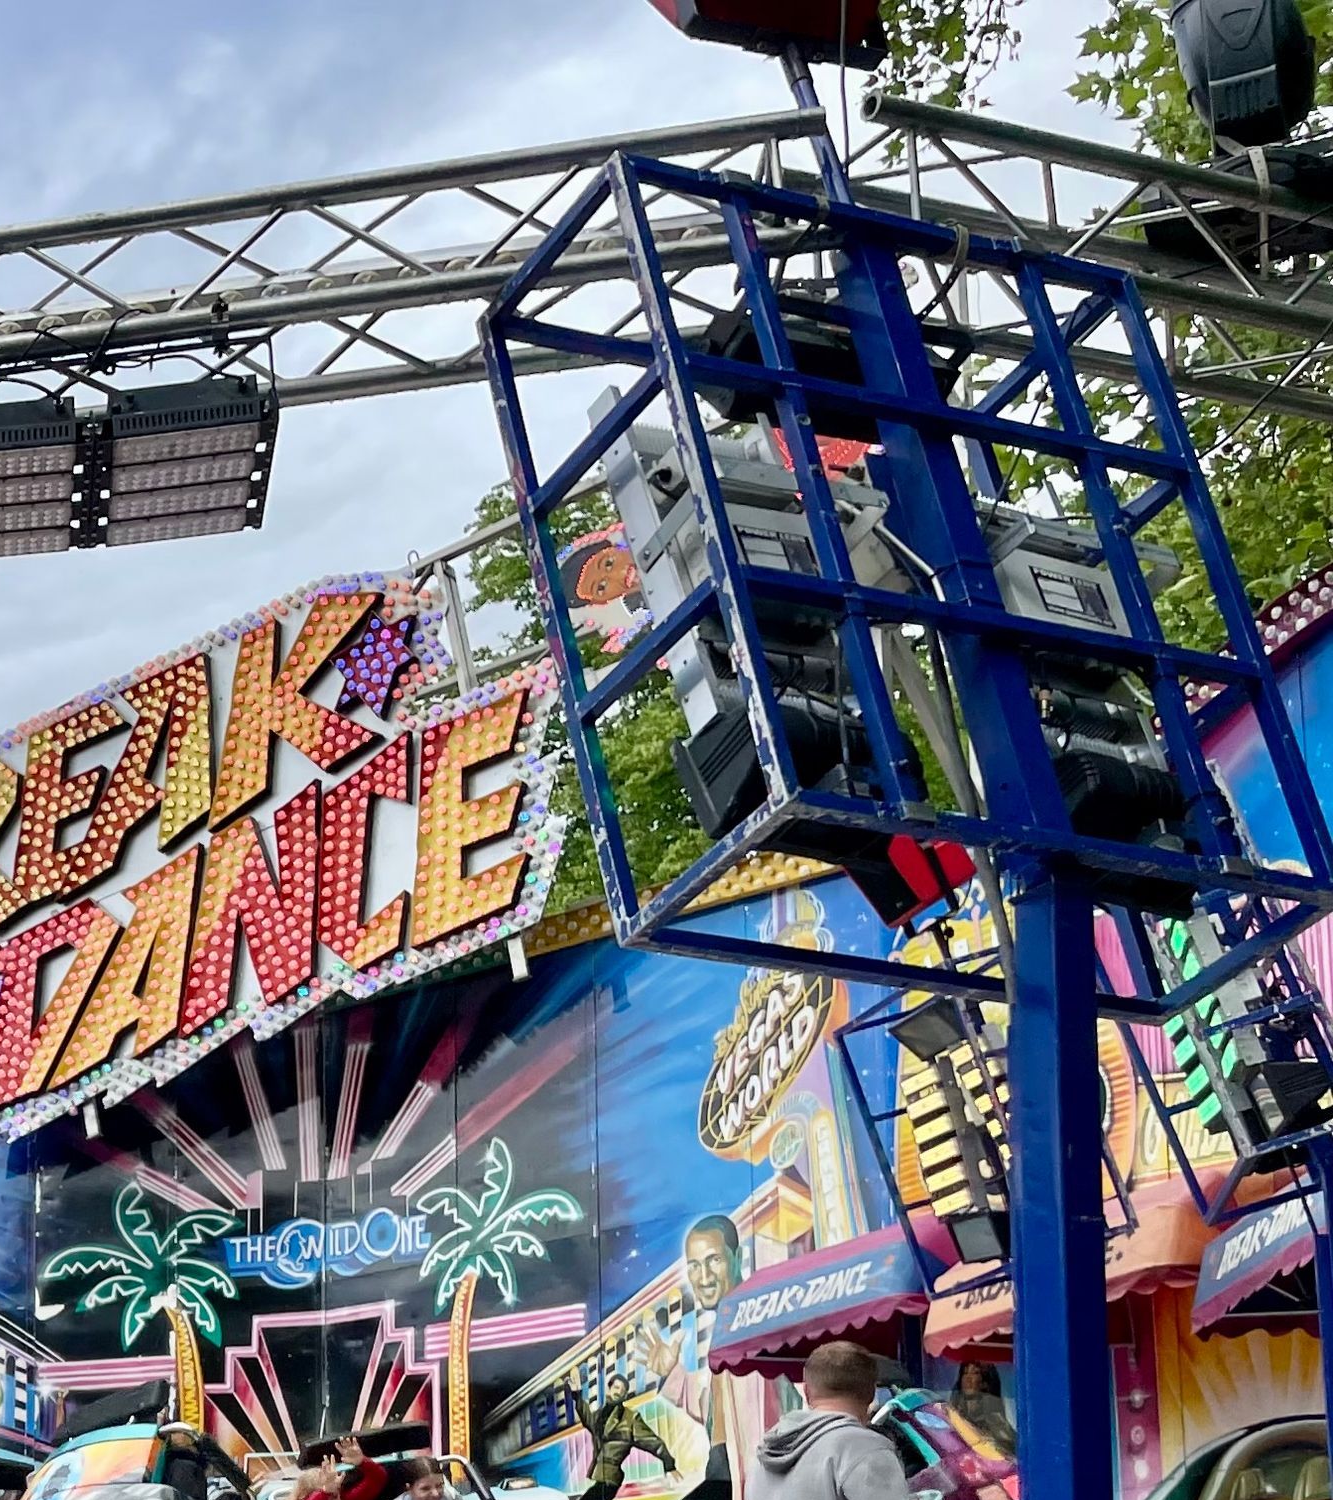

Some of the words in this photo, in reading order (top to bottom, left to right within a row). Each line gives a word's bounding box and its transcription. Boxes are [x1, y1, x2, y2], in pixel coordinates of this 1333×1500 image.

[716, 970, 804, 1095] VEGAS
[718, 1004, 817, 1142] WORLD
[229, 1235, 277, 1263] THE
[362, 1206, 430, 1257] ONE
[729, 1284, 801, 1332] BREAK
[804, 1261, 873, 1309] DANCE
